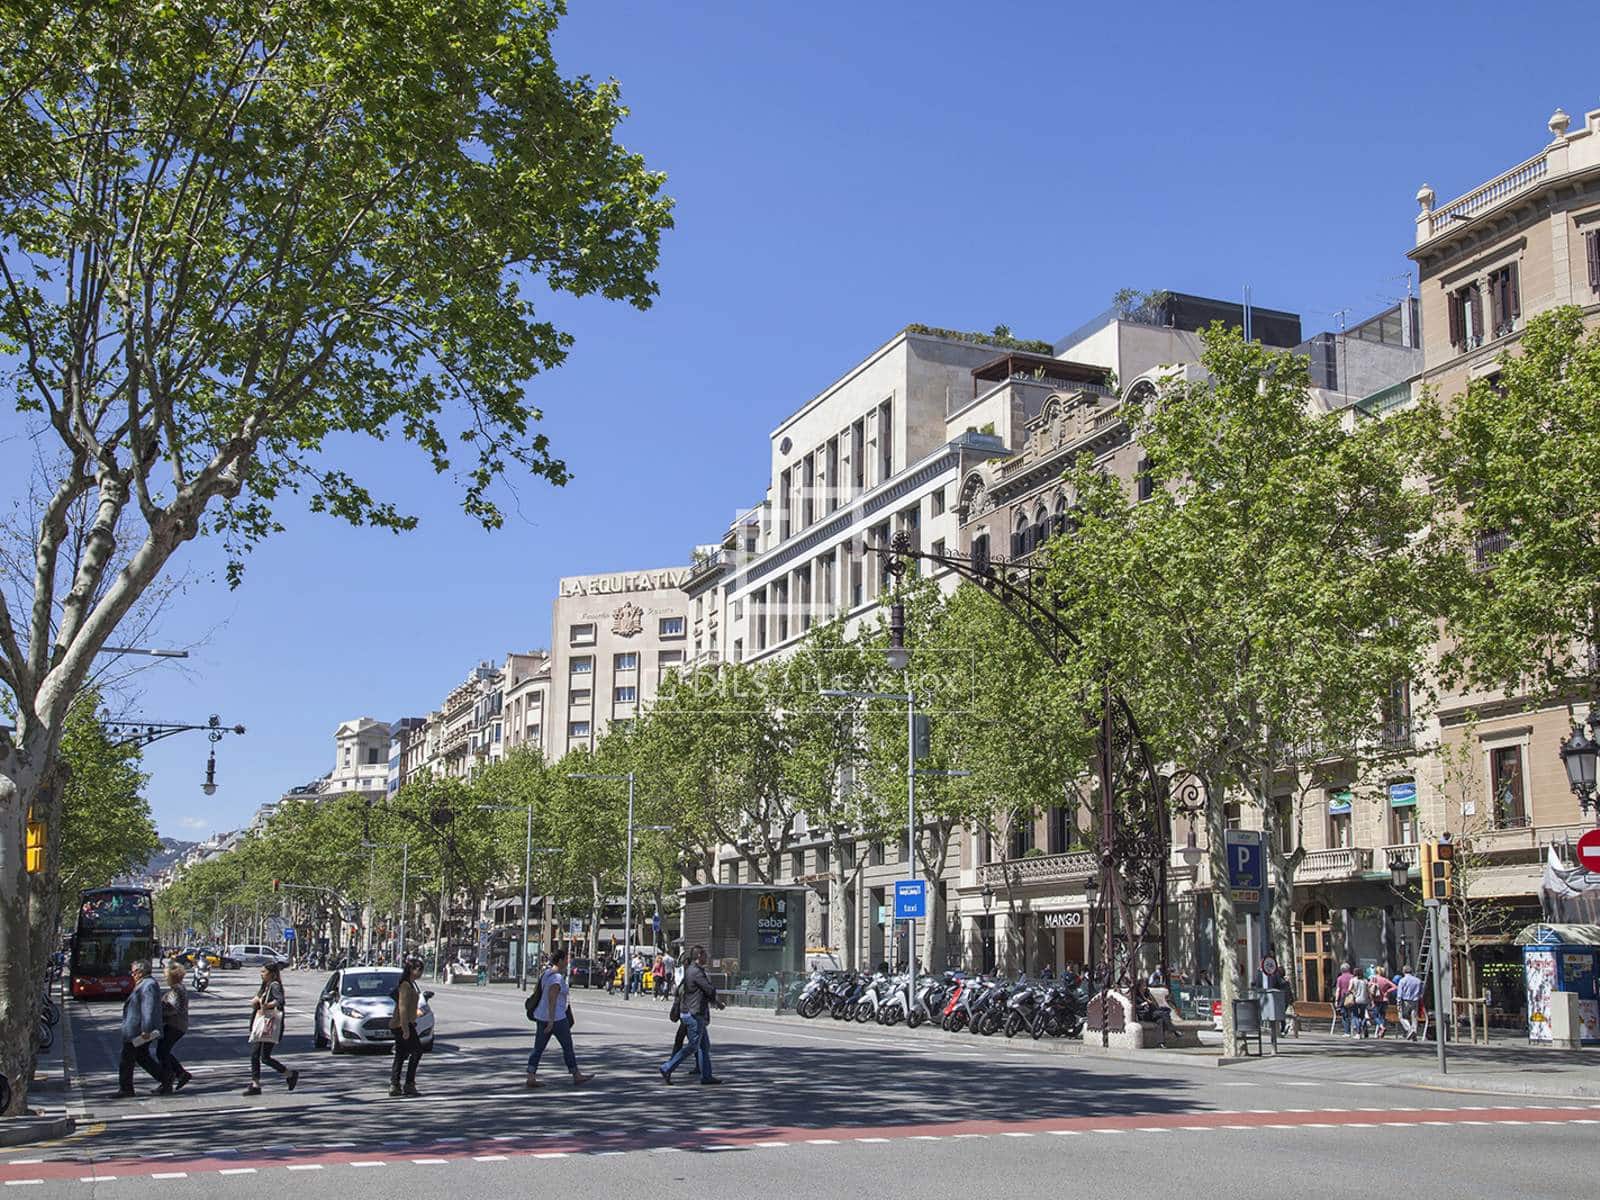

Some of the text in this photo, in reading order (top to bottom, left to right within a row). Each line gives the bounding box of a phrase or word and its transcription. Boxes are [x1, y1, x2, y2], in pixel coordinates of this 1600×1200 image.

[560, 578, 586, 597] LA
[1237, 846, 1251, 872] P
[903, 903, 918, 912] taxi
[758, 916, 783, 928] saba
[1044, 912, 1081, 927] MANGO
